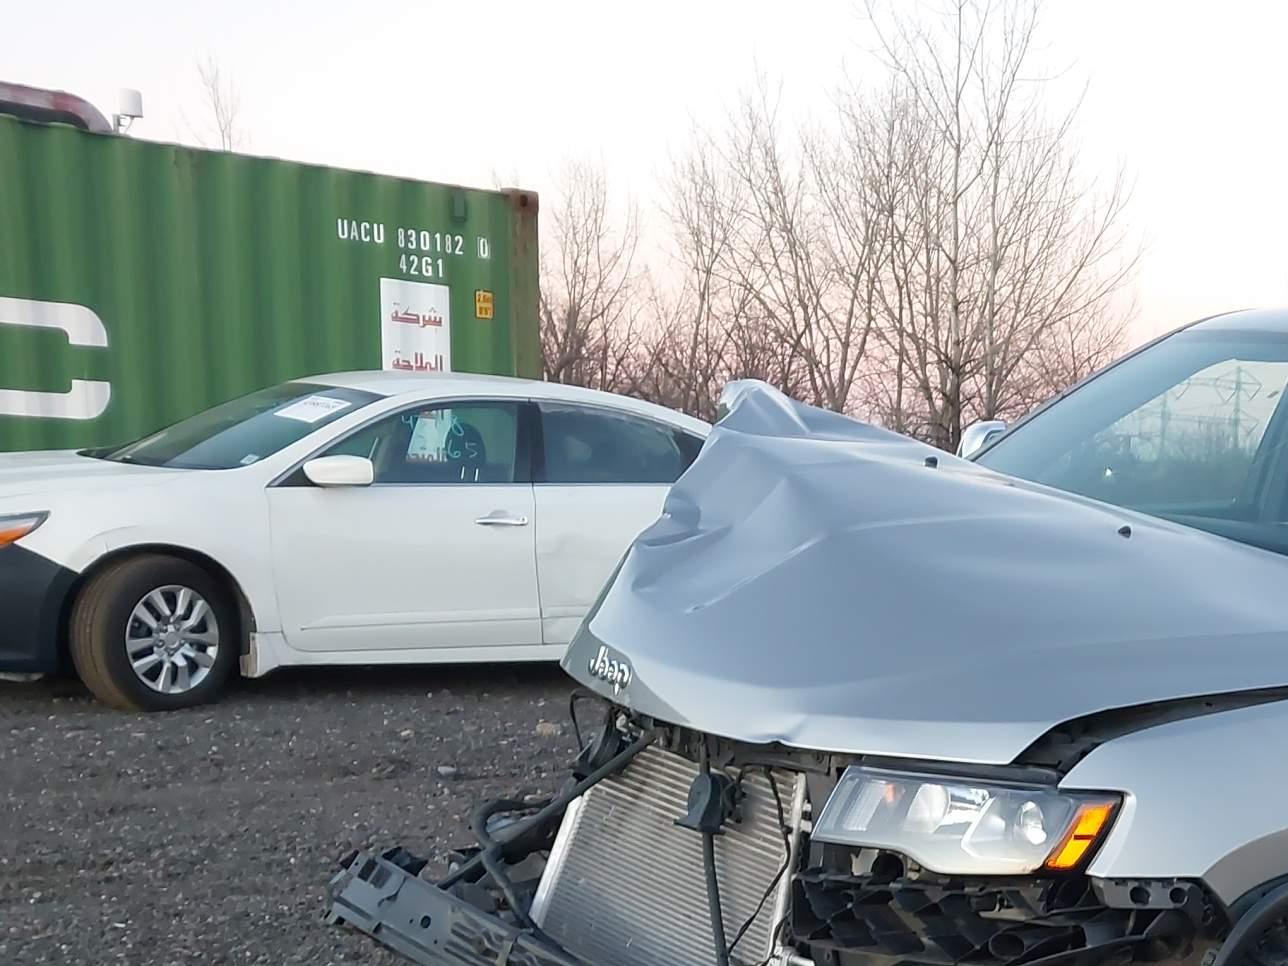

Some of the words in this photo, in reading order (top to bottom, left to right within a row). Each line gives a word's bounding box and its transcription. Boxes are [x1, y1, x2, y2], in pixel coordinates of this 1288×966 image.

[337, 218, 384, 243] UACU
[398, 228, 464, 255] 830182
[399, 254, 443, 277] 42G1
[391, 302, 443, 328] شركة
[589, 645, 632, 695] Jeep
